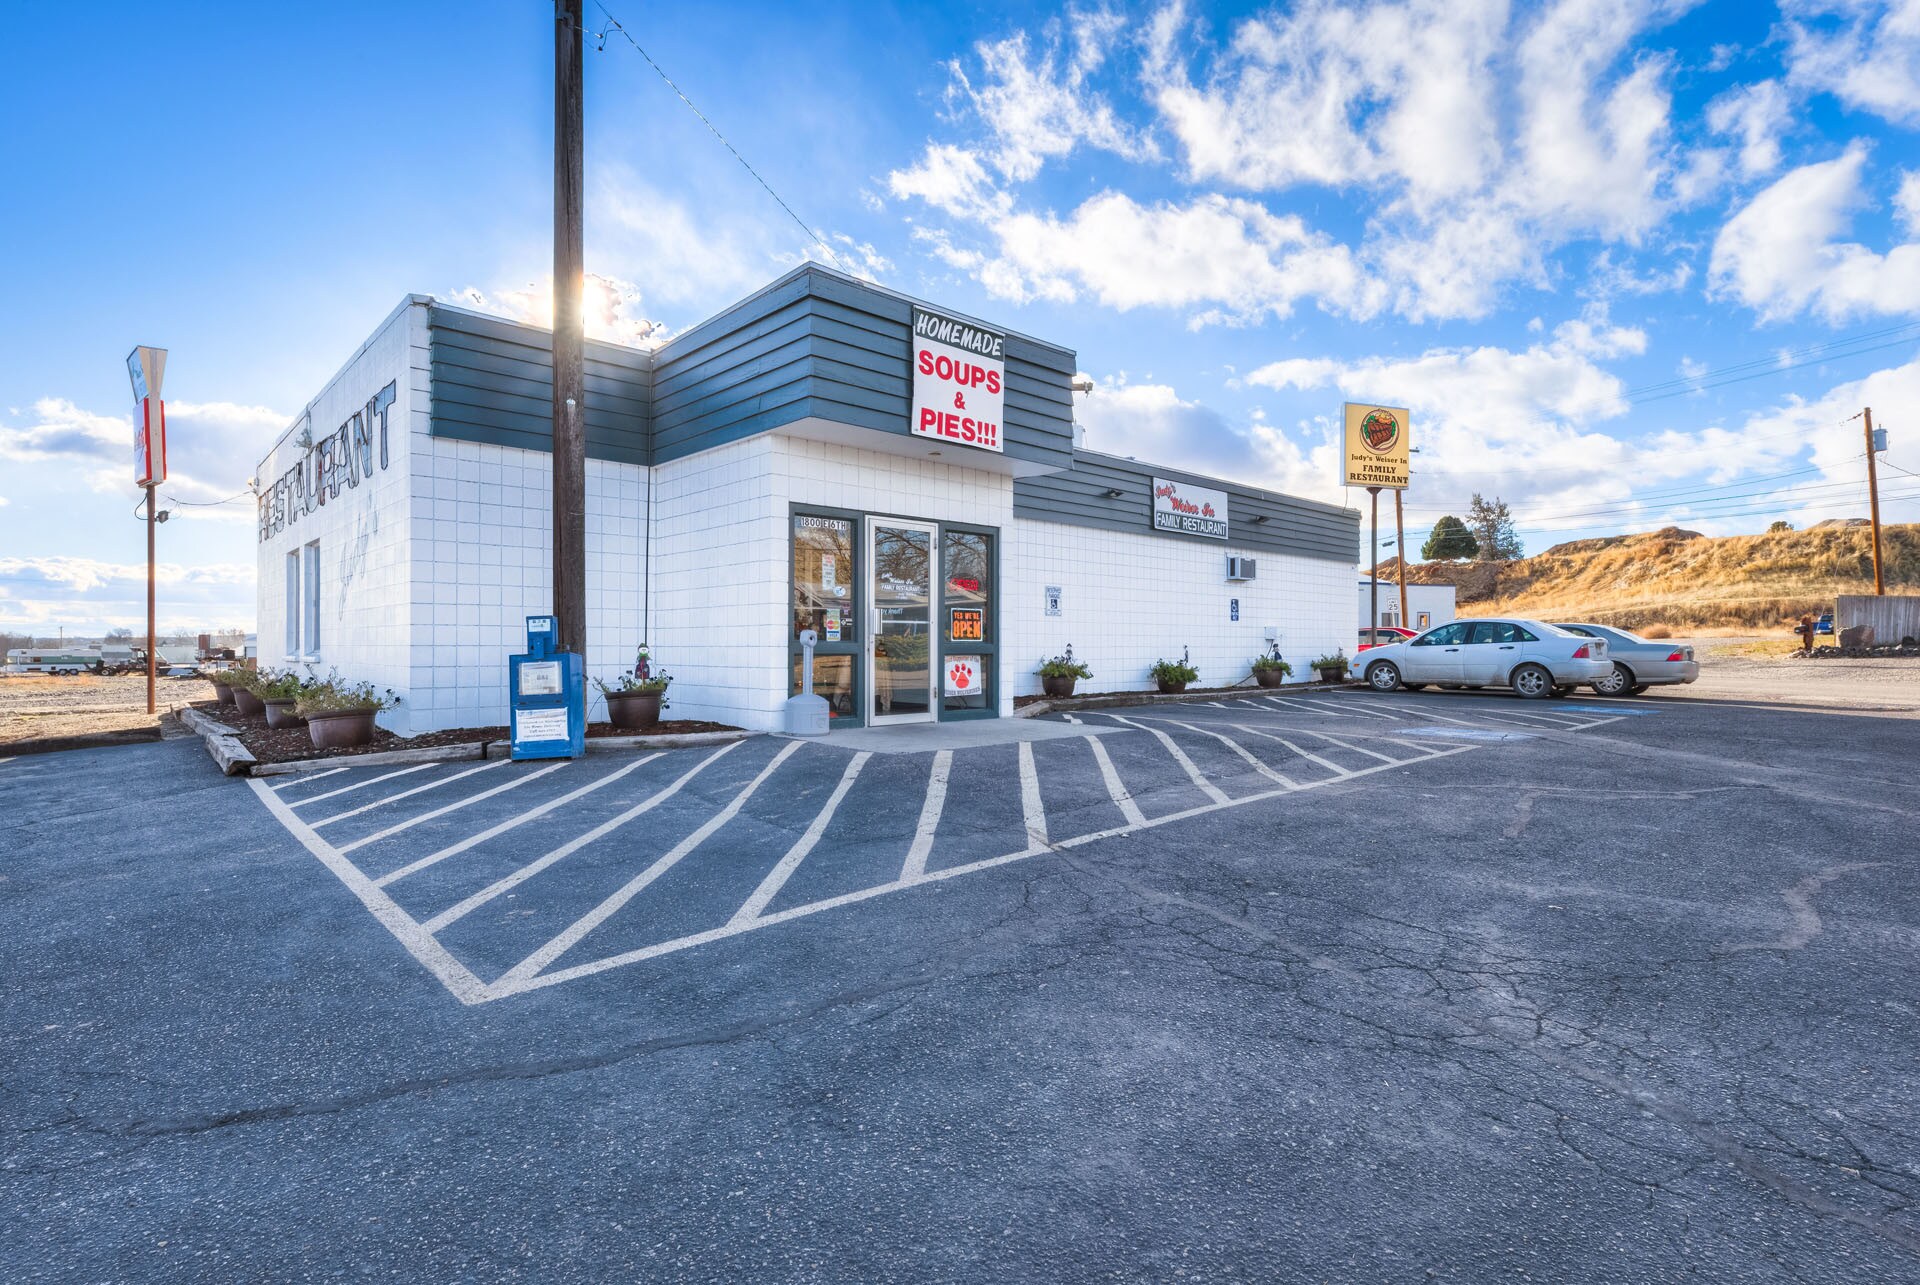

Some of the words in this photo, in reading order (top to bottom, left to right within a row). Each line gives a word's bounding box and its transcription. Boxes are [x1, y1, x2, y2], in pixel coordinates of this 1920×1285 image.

[916, 313, 1003, 356] HOMEMADE
[918, 349, 1001, 394] SOUPS
[954, 391, 966, 410] &
[919, 407, 996, 446] PIES!!!
[258, 378, 397, 544] RESTAURANT
[1352, 454, 1373, 462] Judy's
[1375, 456, 1398, 464] Weiser
[1350, 472, 1409, 484] RESTAURANT
[1362, 464, 1397, 474] FAMILY
[1170, 496, 1199, 516] Weiser
[1202, 502, 1216, 519] In
[801, 517, 821, 527] 1800
[1156, 512, 1181, 529] FAMILY
[1182, 517, 1226, 536] RESTAURANT
[953, 611, 963, 619] YES
[965, 612, 980, 621] WE'RE
[952, 621, 981, 638] OPEN
